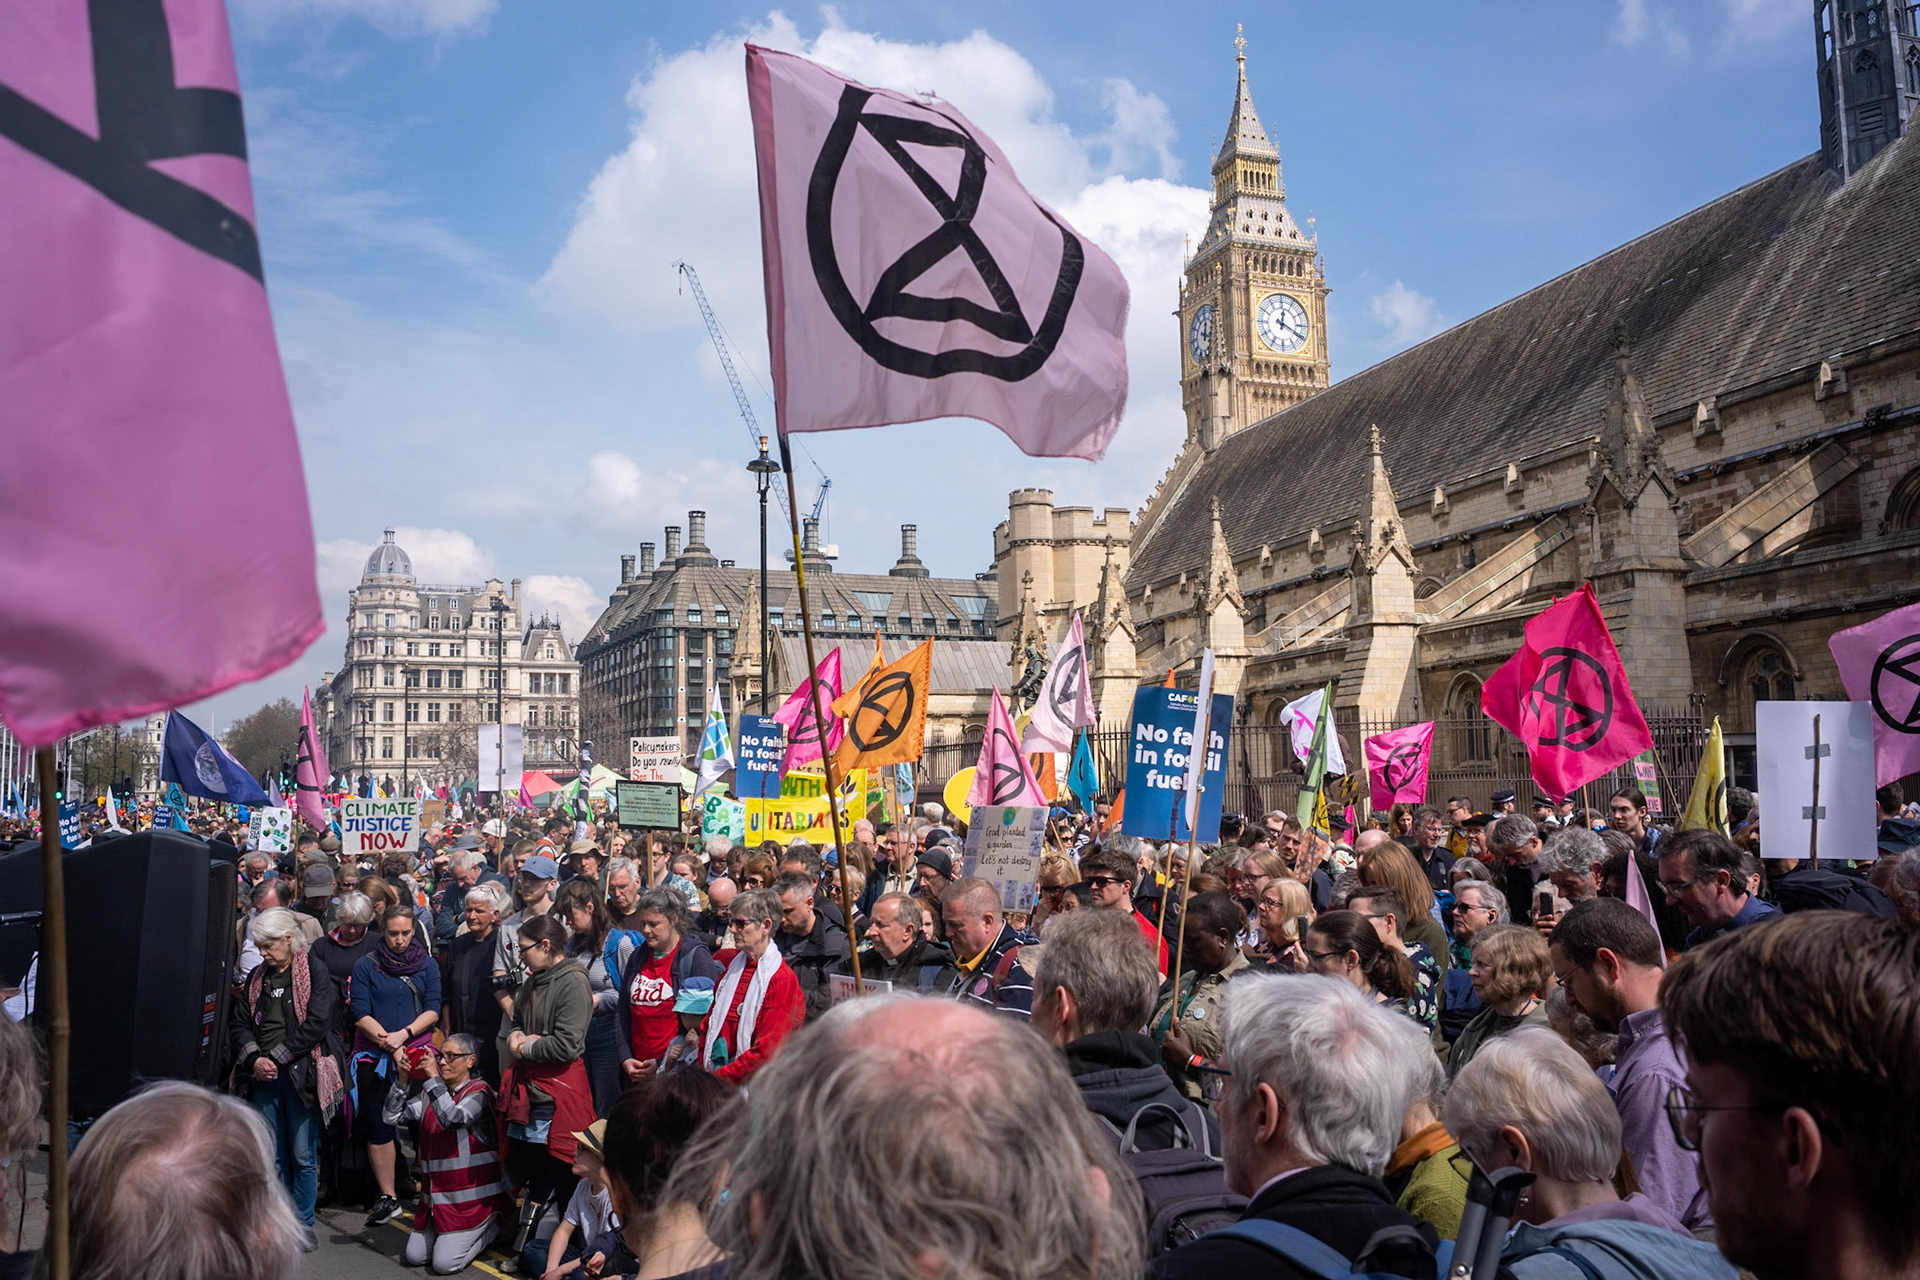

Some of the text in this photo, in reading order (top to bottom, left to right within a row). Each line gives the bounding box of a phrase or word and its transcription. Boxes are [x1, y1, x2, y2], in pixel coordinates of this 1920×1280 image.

[741, 735, 760, 746] No
[1136, 723, 1224, 750] No fah
[632, 740, 680, 754] Policymakers
[741, 746, 754, 758] in
[632, 756, 680, 770] Do you really
[1134, 743, 1221, 772] in fosil
[747, 760, 778, 772] fuels.
[632, 768, 664, 782] See The
[782, 776, 820, 798] OUTH
[345, 802, 416, 817] CLIMATE
[59, 818, 70, 828] No
[345, 816, 412, 832] JUSTICE
[60, 827, 68, 836] in
[986, 824, 1026, 840] God planted
[360, 832, 408, 850] NOW
[981, 854, 1032, 871] Let's not destroy
[632, 982, 664, 1002] aid
